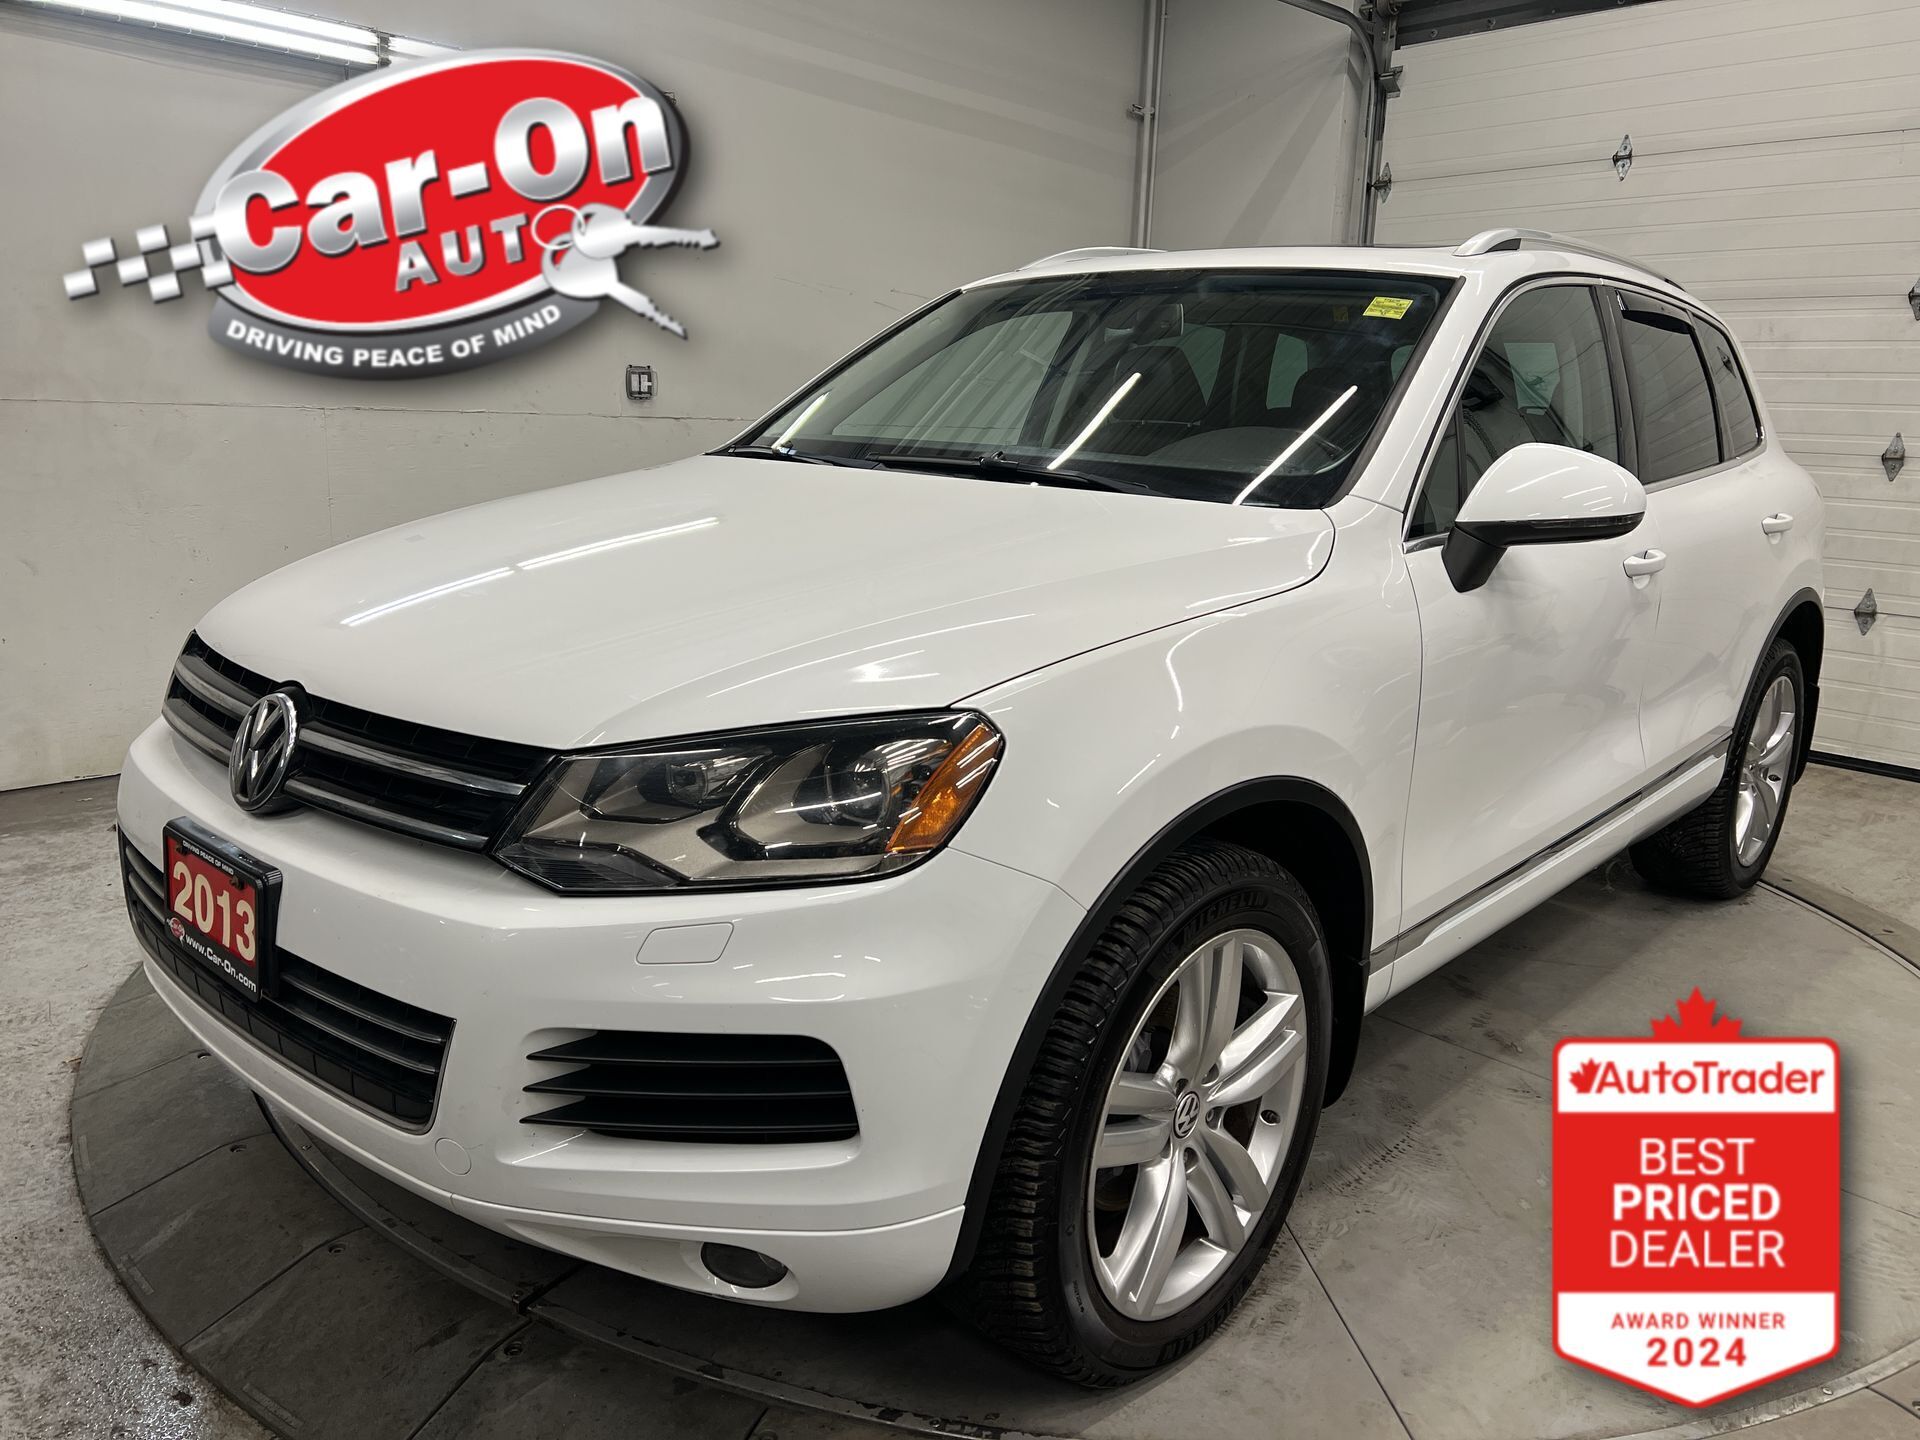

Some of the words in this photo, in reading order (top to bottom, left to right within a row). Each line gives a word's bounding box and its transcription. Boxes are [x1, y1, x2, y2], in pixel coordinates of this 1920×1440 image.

[200, 850, 215, 864] PEACE
[215, 859, 222, 867] OF
[173, 861, 256, 961] 2013
[185, 934, 257, 993] www.Car-On.com
